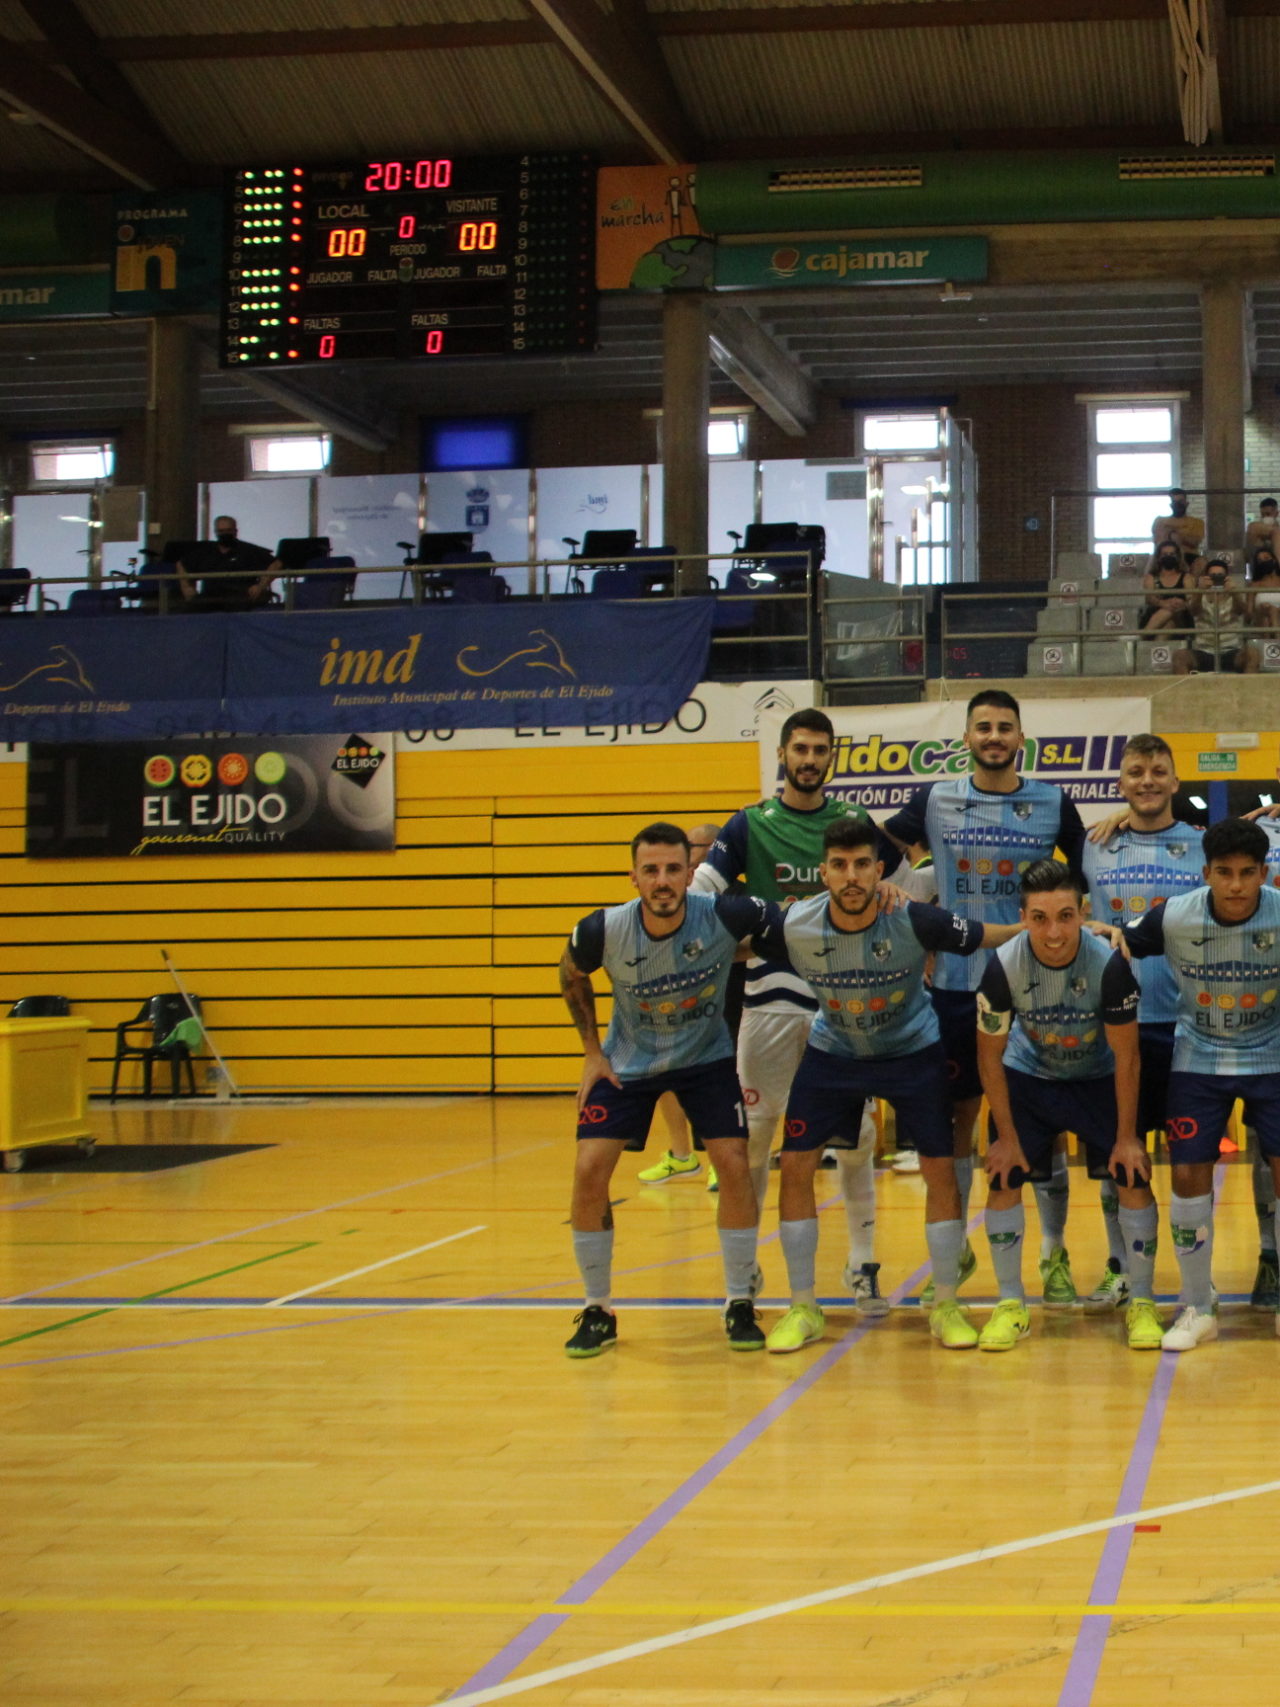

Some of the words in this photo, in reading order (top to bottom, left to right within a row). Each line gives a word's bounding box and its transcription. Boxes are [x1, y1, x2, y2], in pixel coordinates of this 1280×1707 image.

[521, 156, 529, 166] 4
[365, 159, 452, 192] 20:00
[521, 172, 528, 183] 5
[520, 188, 528, 199] 6
[318, 204, 370, 219] LOCAL
[446, 198, 498, 213] VISITANTE
[520, 205, 528, 215] 7
[117, 208, 188, 221] PROGRAMA
[601, 207, 665, 227] marcha
[398, 215, 416, 239] 0
[519, 221, 528, 232] 8
[328, 228, 367, 257] 00
[459, 222, 498, 251] 00
[518, 238, 528, 249] 9
[389, 244, 426, 256] PERIODO
[233, 252, 242, 263] 9
[514, 255, 527, 265] 10
[805, 245, 930, 277] cajamar
[229, 270, 241, 280] 10
[308, 271, 352, 283] JUGADOR
[414, 266, 460, 279] JUGADOR
[477, 264, 507, 276] FALTA
[515, 272, 527, 282] 11
[230, 286, 241, 296] 11
[514, 288, 526, 299] 12
[228, 302, 241, 313] 12
[513, 305, 526, 315] 13
[227, 318, 240, 329] 13
[304, 317, 341, 330] FALTAS
[411, 314, 448, 326] FALTAS
[513, 322, 526, 332] 14
[227, 335, 240, 345] 14
[426, 330, 443, 354] 0
[512, 338, 525, 349] 15
[319, 335, 336, 359] 0
[227, 352, 240, 363] 15
[318, 633, 422, 687] imd
[332, 693, 386, 707] Instituto
[390, 687, 457, 704] Municipal
[461, 687, 476, 700] de
[481, 686, 537, 702] Deportes
[539, 686, 554, 699] de
[558, 685, 575, 698] El
[577, 684, 613, 699] Ejido
[1041, 742, 1083, 765] S.L.
[337, 758, 349, 768] EL
[351, 757, 379, 768] EJIDO
[824, 782, 891, 808] RACIÓN
[894, 781, 911, 804] DE
[142, 796, 180, 826] EL
[191, 792, 286, 826] EJIDO
[129, 823, 249, 856] gourmet
[224, 831, 285, 843] QUALITY
[775, 863, 821, 883] Dur
[956, 878, 975, 894] EL
[1196, 1012, 1216, 1028] EL
[1223, 1007, 1276, 1029] EJIDO
